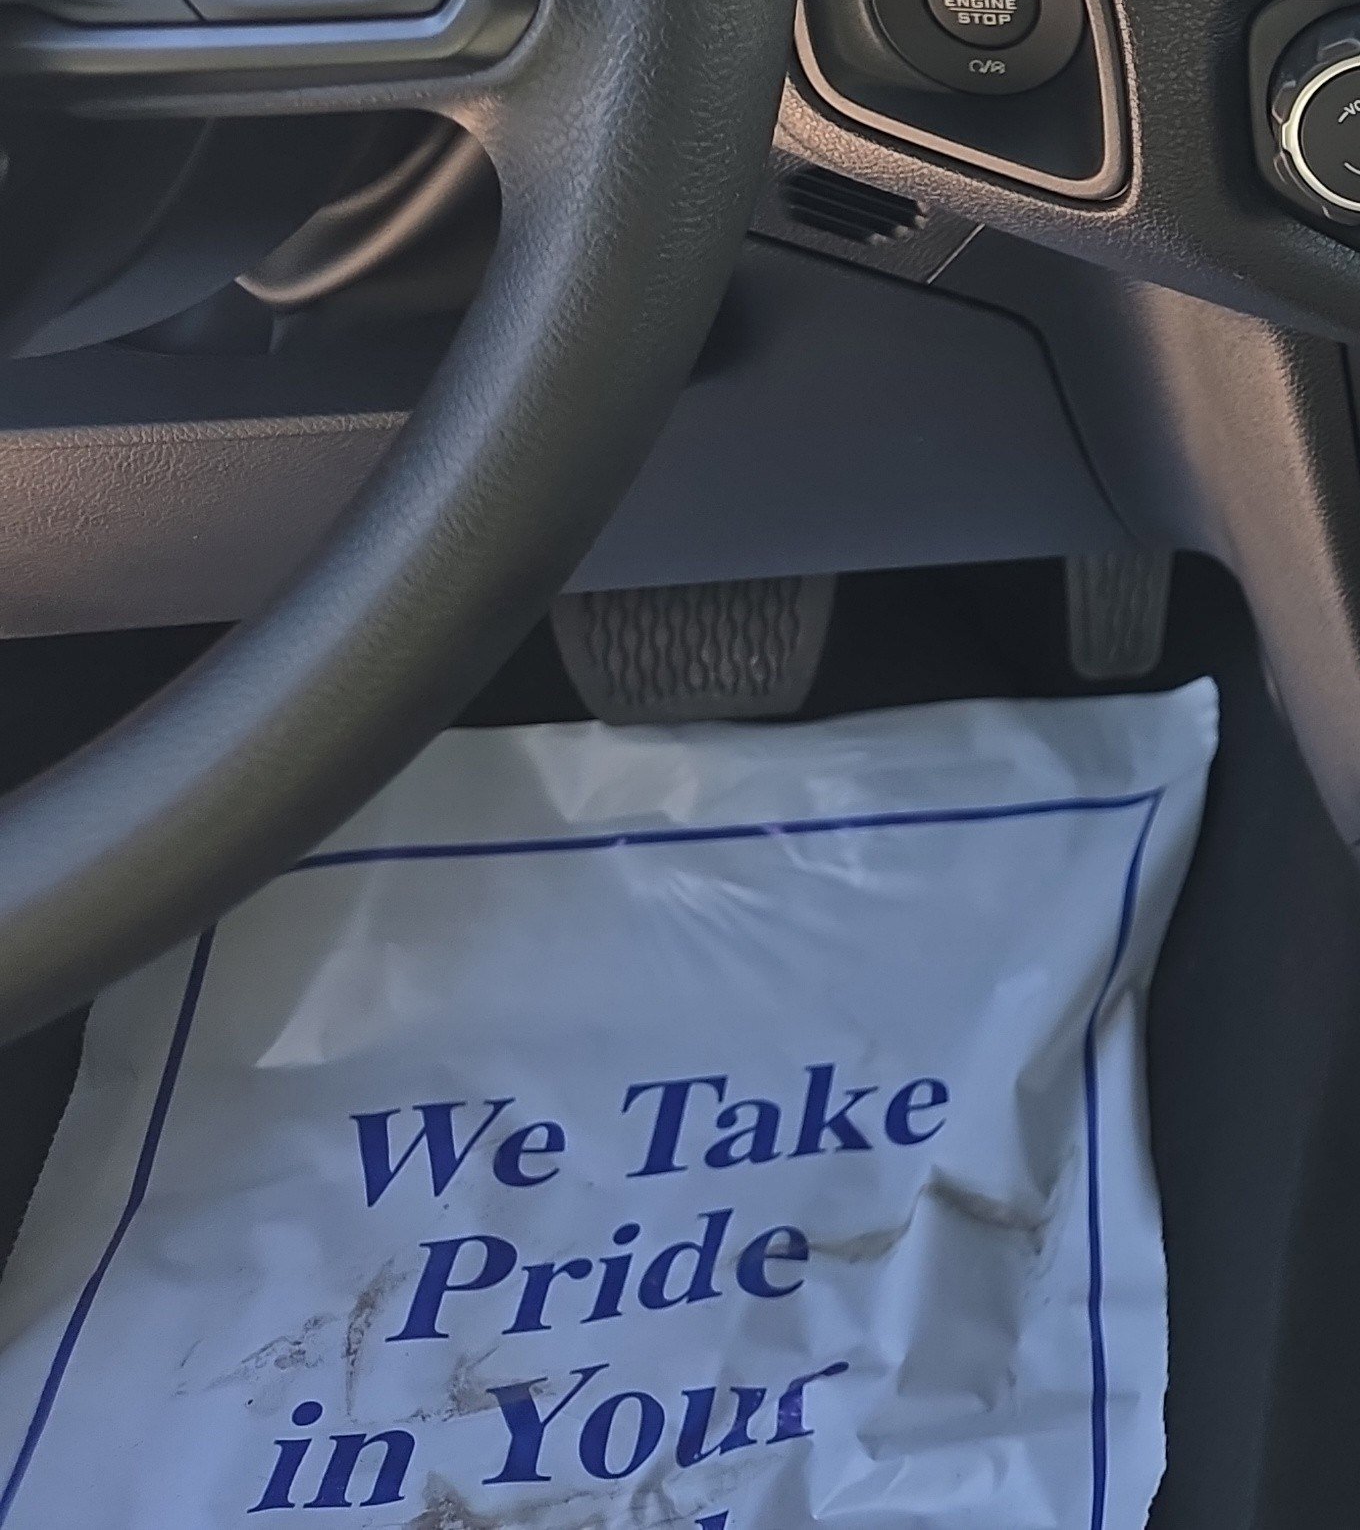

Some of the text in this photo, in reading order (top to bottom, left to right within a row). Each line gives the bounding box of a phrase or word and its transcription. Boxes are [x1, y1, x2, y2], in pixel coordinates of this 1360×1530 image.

[957, 11, 1012, 26] STOP
[349, 1062, 950, 1209] We Take
[384, 1208, 810, 1343] Pride
[246, 1361, 849, 1515] in Your
